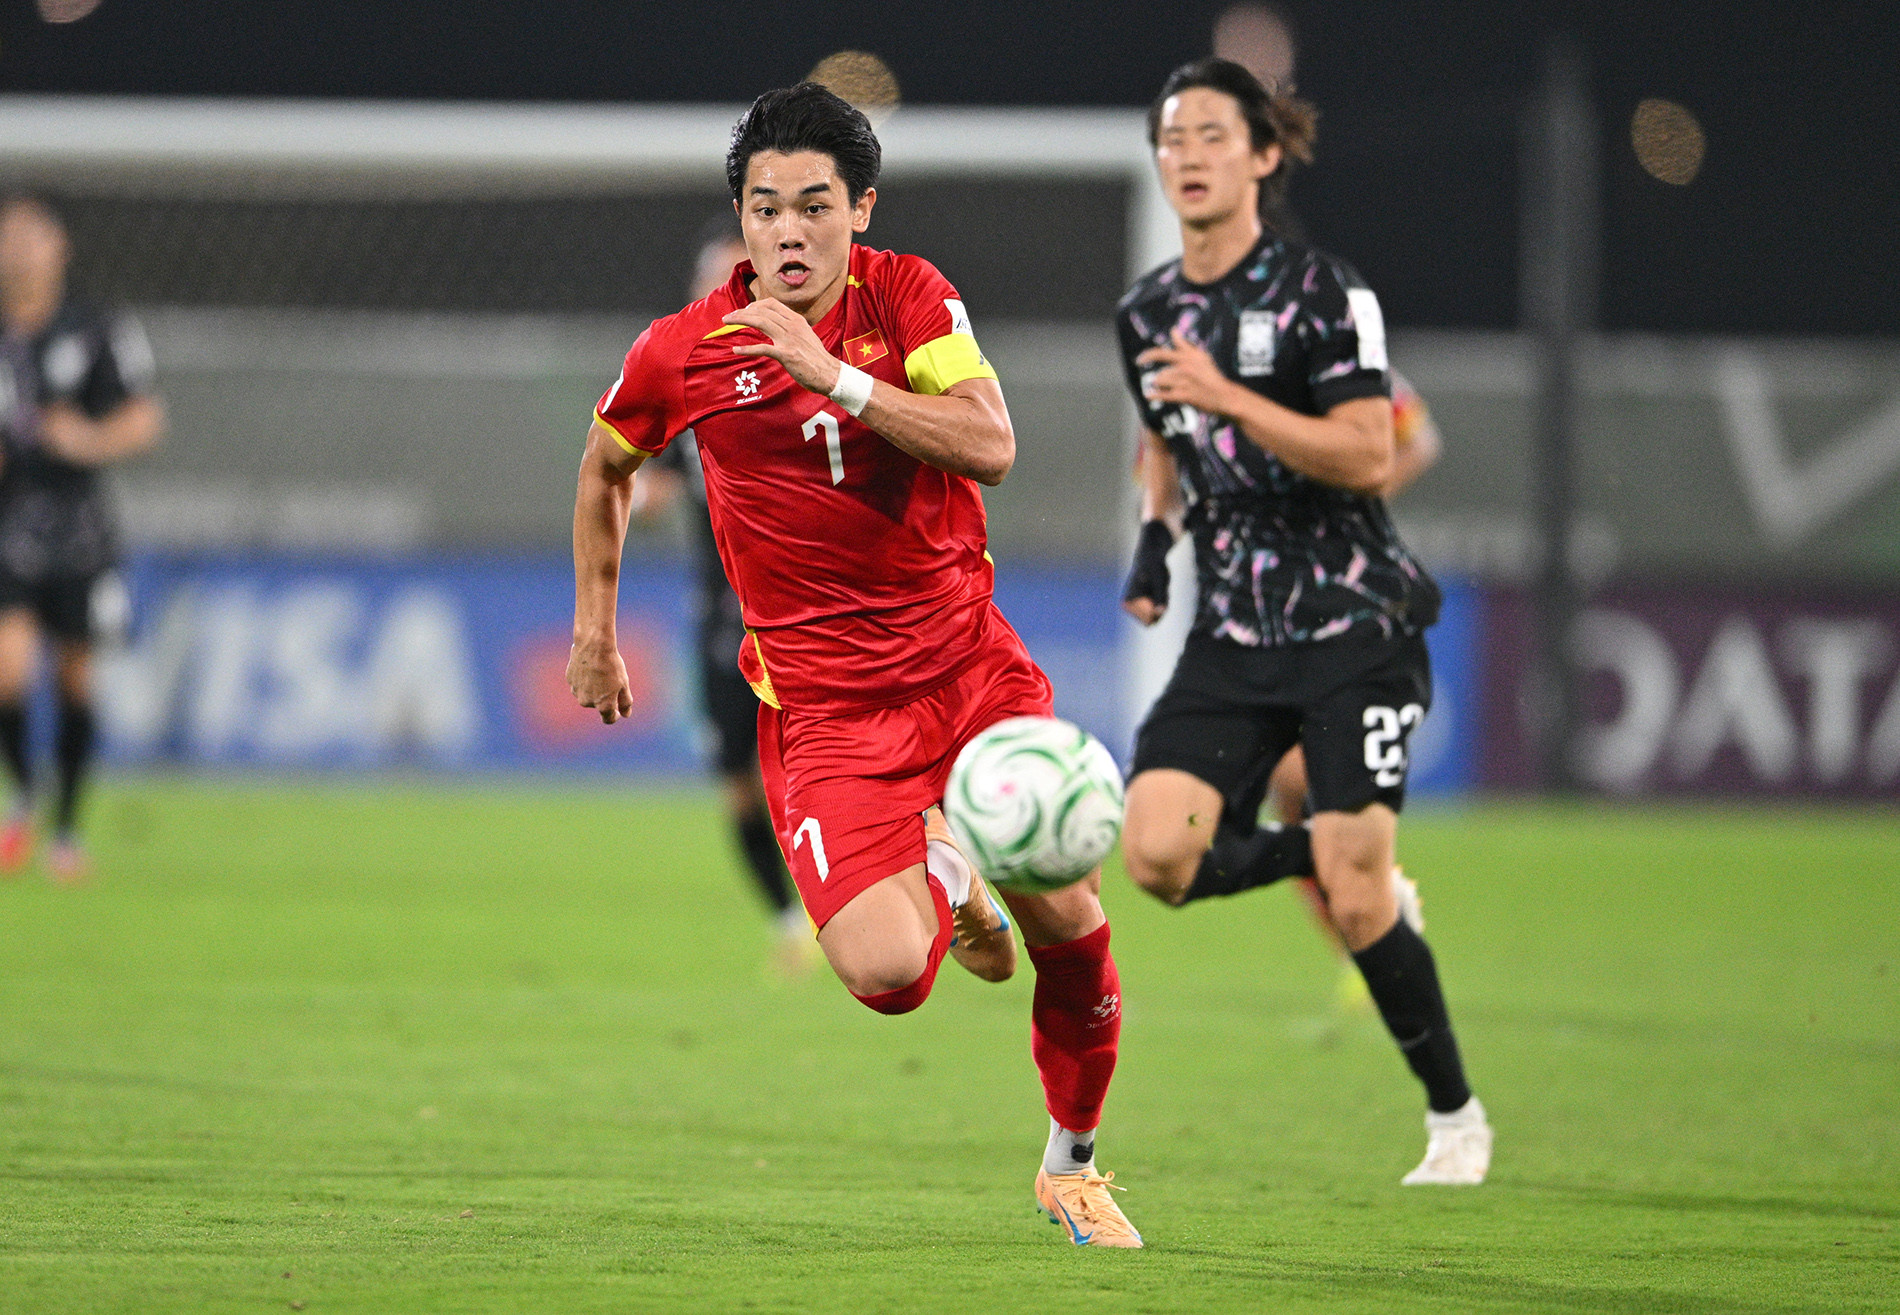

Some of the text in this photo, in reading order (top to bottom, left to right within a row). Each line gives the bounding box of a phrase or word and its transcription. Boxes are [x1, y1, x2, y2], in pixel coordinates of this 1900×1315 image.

[801, 410, 845, 487] 7
[90, 578, 478, 756] VISA
[1520, 605, 1900, 793] QAT
[793, 816, 829, 884] 7
